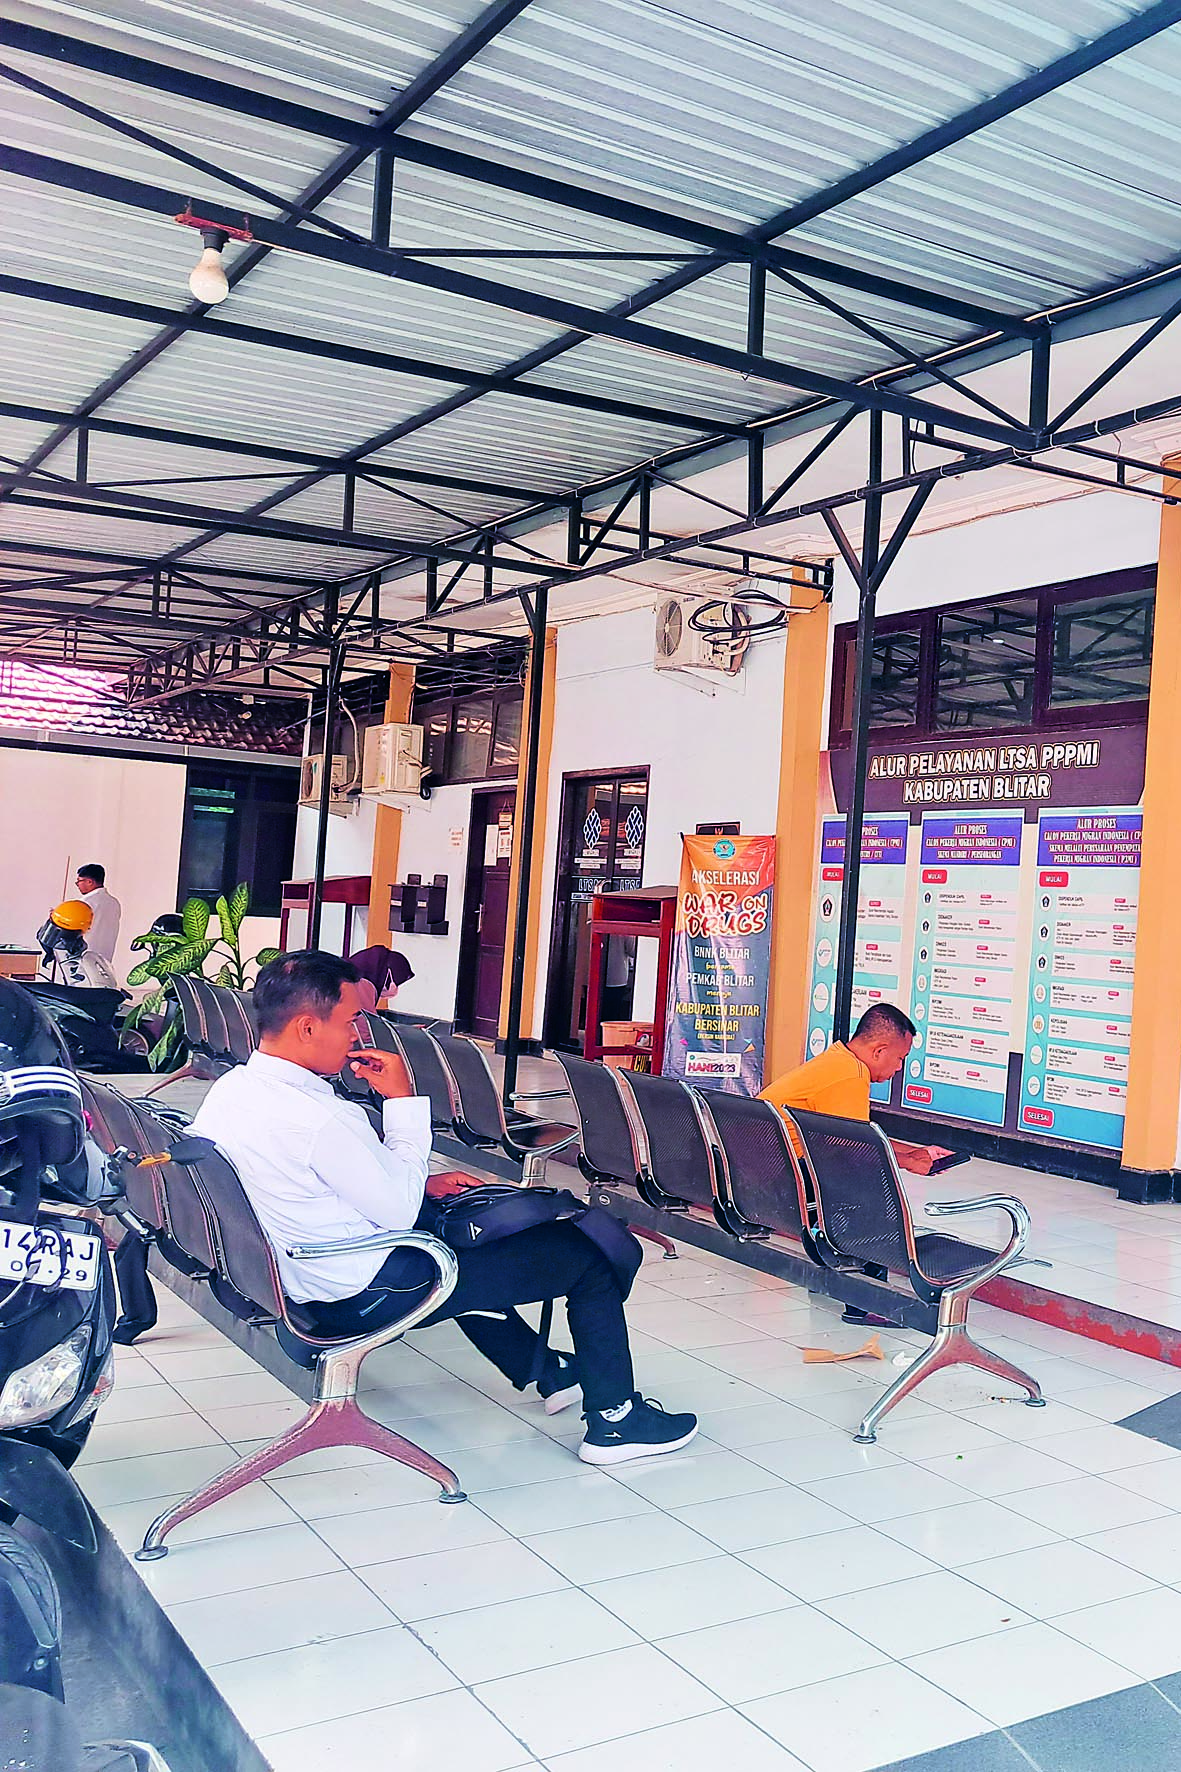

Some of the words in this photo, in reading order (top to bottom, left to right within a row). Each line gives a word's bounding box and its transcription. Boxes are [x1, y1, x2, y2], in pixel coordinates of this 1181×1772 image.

[869, 753, 906, 778] ALUR
[909, 749, 994, 775] PELAYANAN
[998, 746, 1039, 772] LTSA
[1042, 742, 1098, 769] PPPMI
[904, 779, 989, 802] KABUPATEN
[993, 775, 1051, 799] BLITAR
[968, 825, 987, 834] PROSES
[1094, 819, 1116, 828] PROSES
[692, 870, 760, 886] AKSELERASI
[683, 892, 736, 913] WAR
[742, 895, 768, 911] ON
[687, 911, 767, 938] DRUGS
[720, 948, 749, 959] BLITAR
[686, 973, 722, 986] PEMKAB
[725, 975, 754, 986] BLITAR
[676, 1002, 727, 1016] KABUPATEN
[729, 1004, 760, 1017] BLITAR
[695, 1019, 739, 1032] BERSINAR
